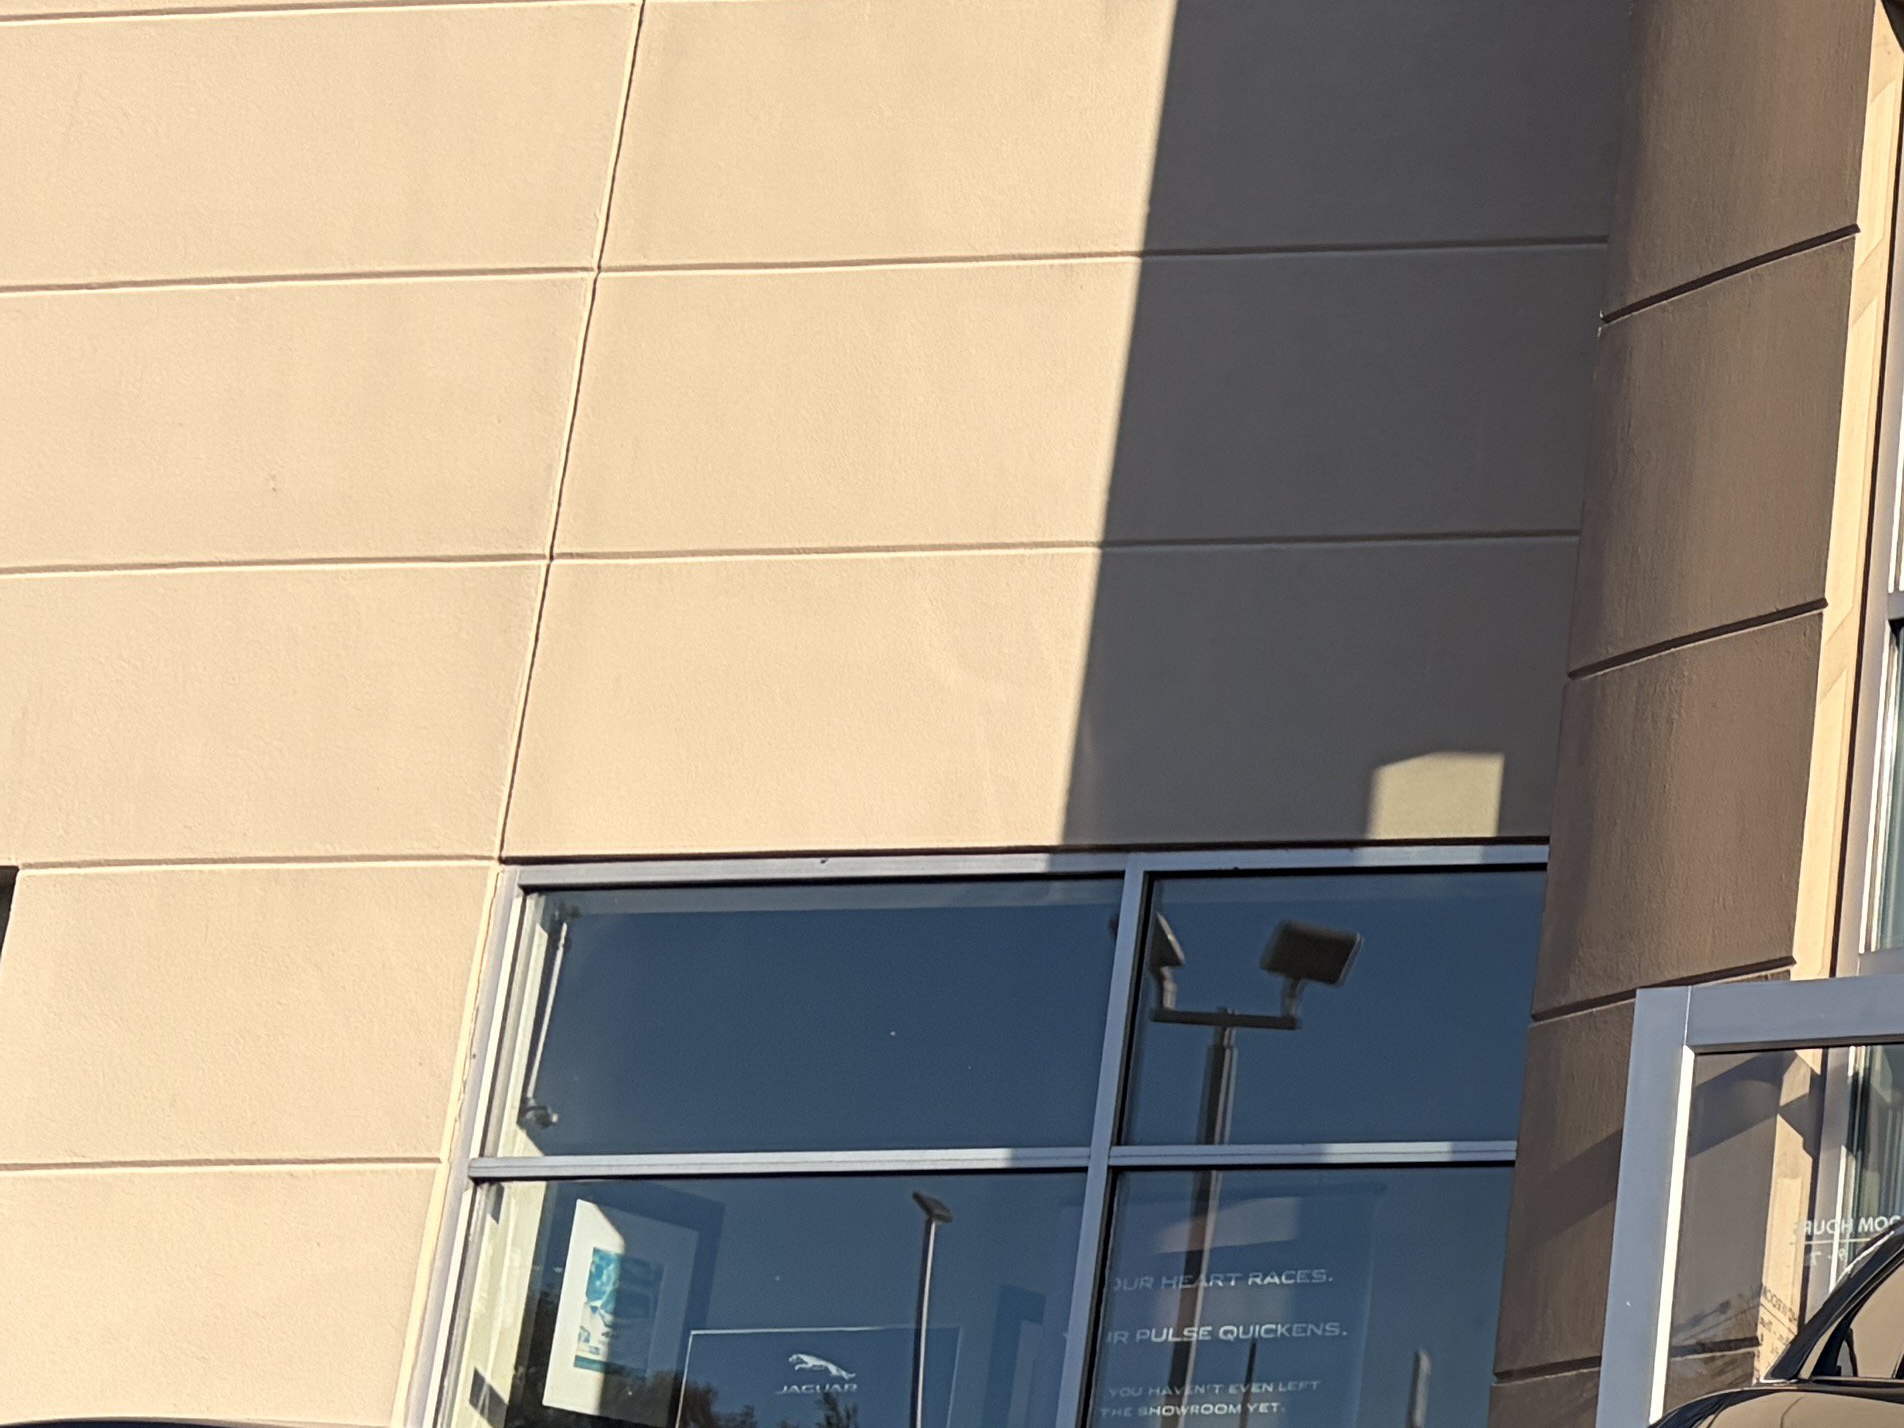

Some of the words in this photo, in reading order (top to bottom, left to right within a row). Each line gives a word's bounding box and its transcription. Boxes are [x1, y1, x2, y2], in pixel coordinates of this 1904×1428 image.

[1160, 1273, 1242, 1290] HEART
[1248, 1269, 1334, 1286] RACES.
[1135, 1326, 1212, 1343] PULSE
[1218, 1322, 1349, 1341] QUICKENS.
[775, 1383, 858, 1395] JAGUAR
[1108, 1386, 1143, 1398] YOU
[1228, 1382, 1274, 1395] EVEN
[1277, 1380, 1322, 1393] LEFT
[1137, 1403, 1242, 1417] SHOWROOM
